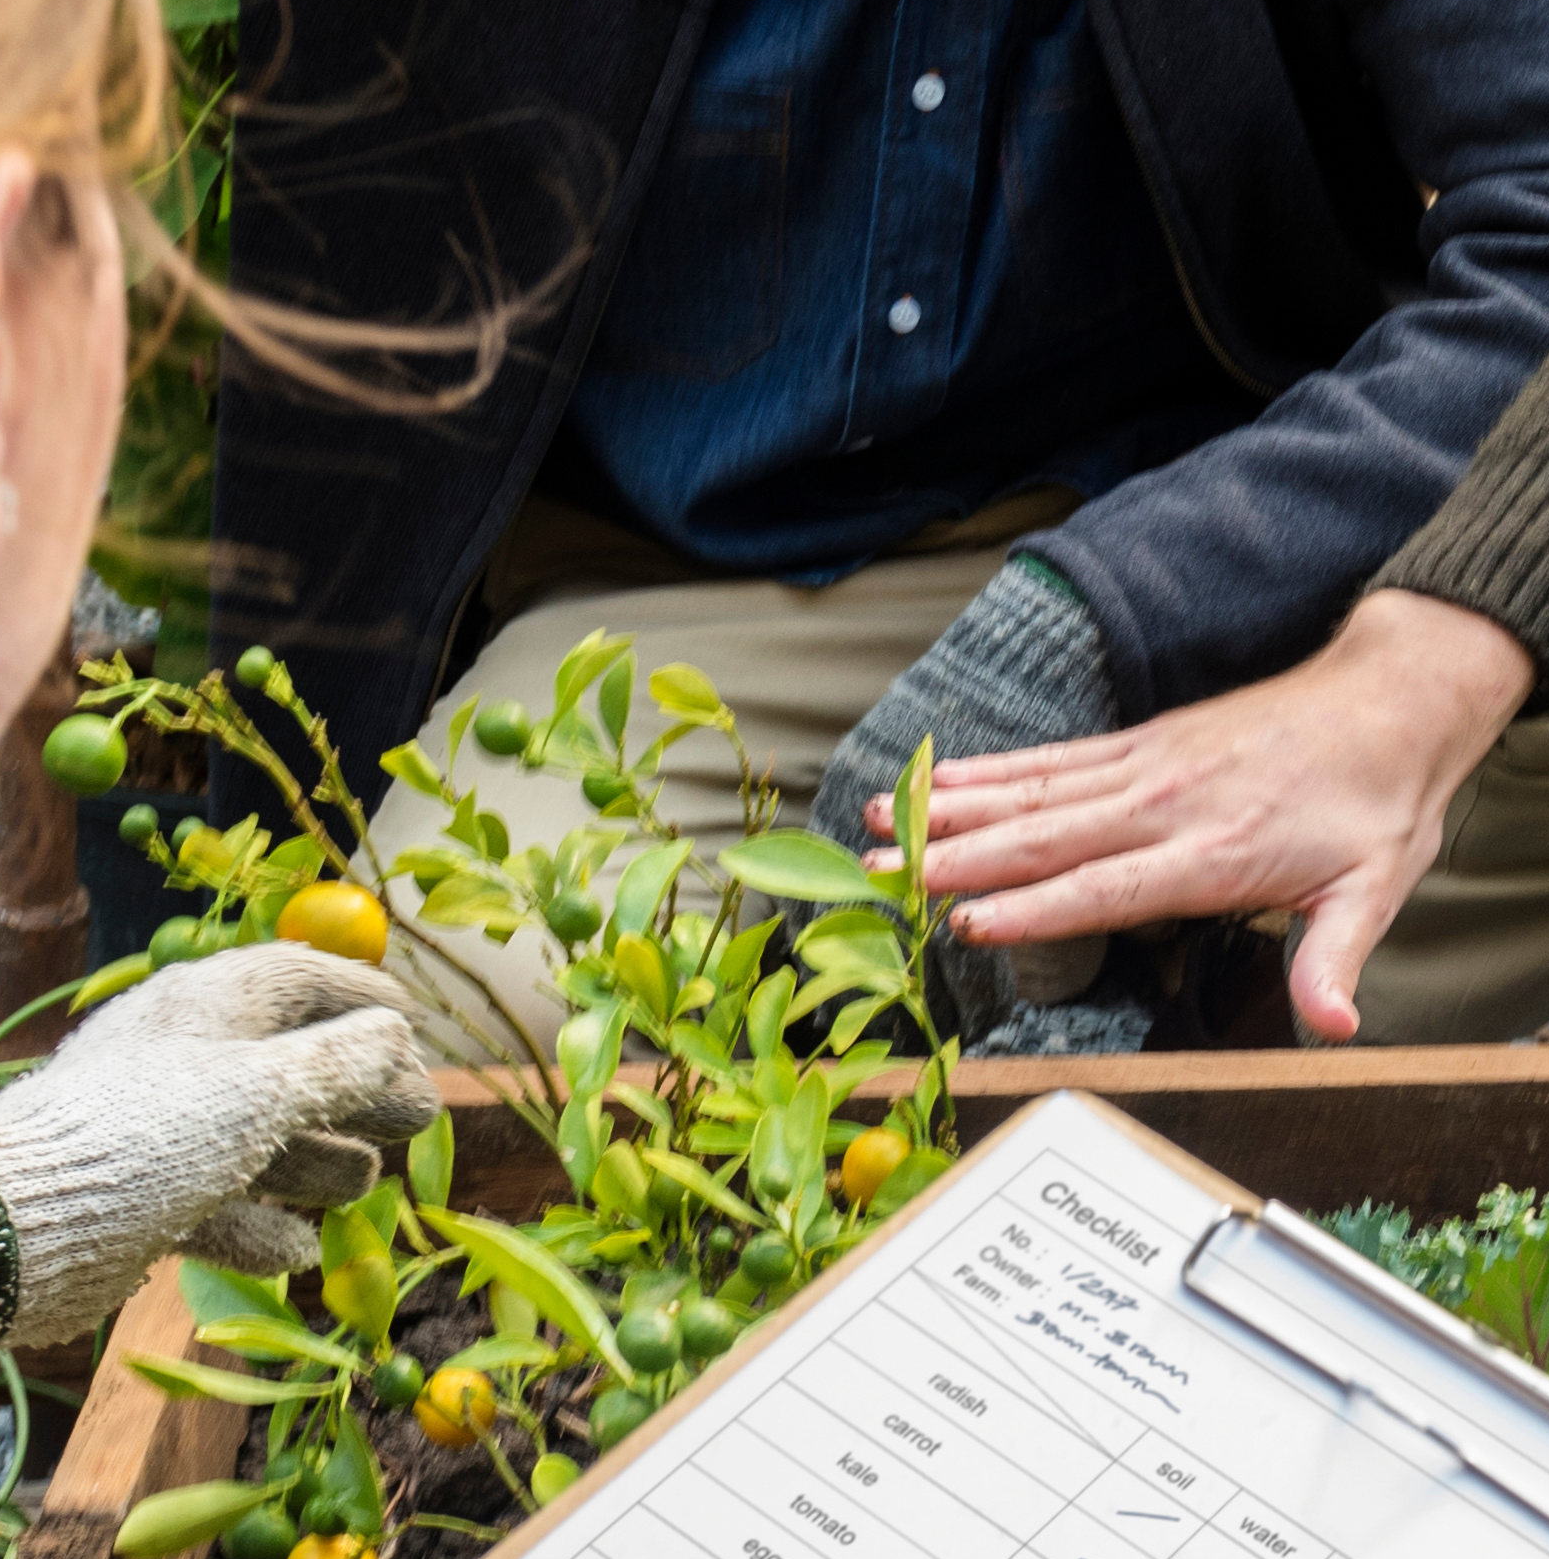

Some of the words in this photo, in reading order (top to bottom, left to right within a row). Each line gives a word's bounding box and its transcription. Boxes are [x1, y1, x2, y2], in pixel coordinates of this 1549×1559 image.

[1040, 1180, 1161, 1267] Checklist
[1058, 1301, 1101, 1332] Mr.
[1105, 1330, 1189, 1386] Brown
[927, 1370, 989, 1419] radish
[883, 1411, 943, 1459] carrot
[836, 1450, 880, 1488] kale
[1155, 1459, 1196, 1492] soil
[789, 1492, 858, 1547] tomato
[1239, 1516, 1298, 1559] water
